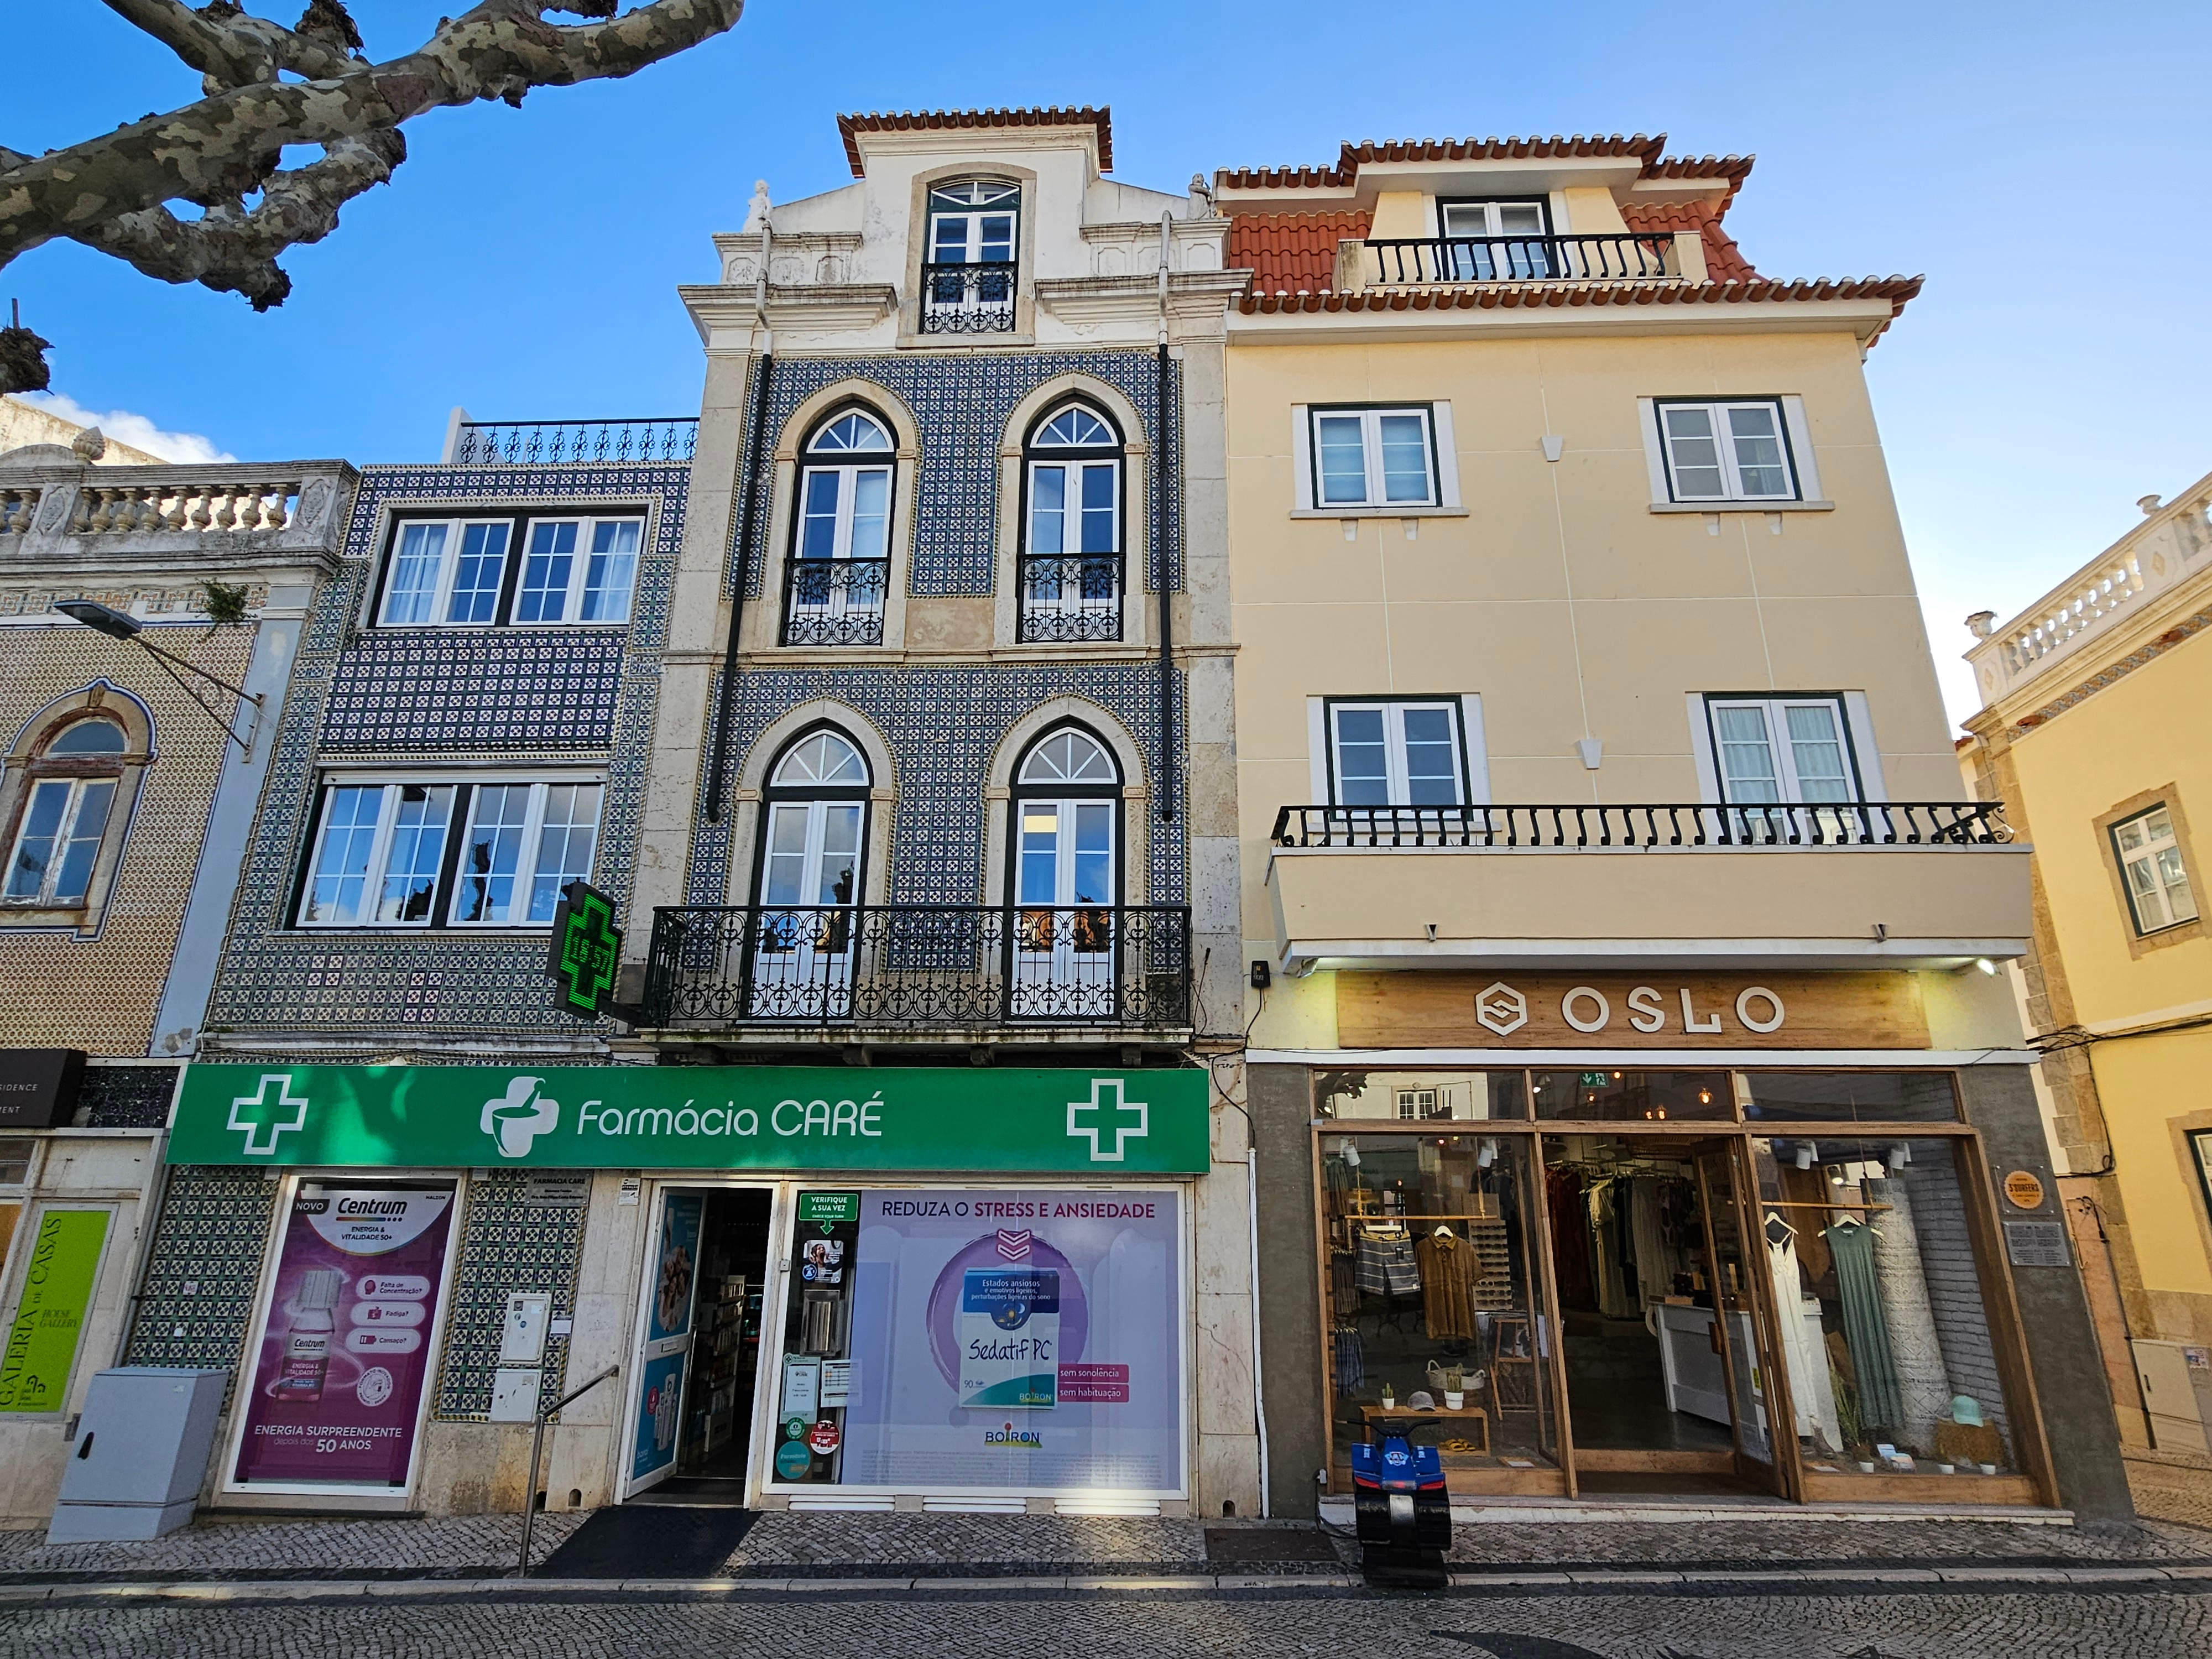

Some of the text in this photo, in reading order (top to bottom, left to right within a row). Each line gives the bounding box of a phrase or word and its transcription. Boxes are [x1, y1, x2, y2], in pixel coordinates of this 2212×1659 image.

[1561, 986, 1785, 1034] OSLO
[577, 1091, 884, 1136] Farmácia CARÉ
[296, 1202, 324, 1211] NOVO
[337, 1197, 408, 1215] Centrum
[882, 1201, 1155, 1218] REDUZA O STRESS E ANSIEDADE
[0, 1310, 38, 1406] GALERIA
[30, 1218, 61, 1285] CASAS
[294, 1338, 325, 1348] Centrum
[969, 1338, 1051, 1360] Sedatif PC
[1078, 1368, 1119, 1377] sonolência
[964, 1380, 973, 1388] 90
[1078, 1387, 1121, 1400] habituação
[254, 1425, 403, 1438] ENERGIA SURPREENDENTE
[985, 1425, 1040, 1443] BOIRON
[316, 1439, 372, 1453] 50 ANOS
